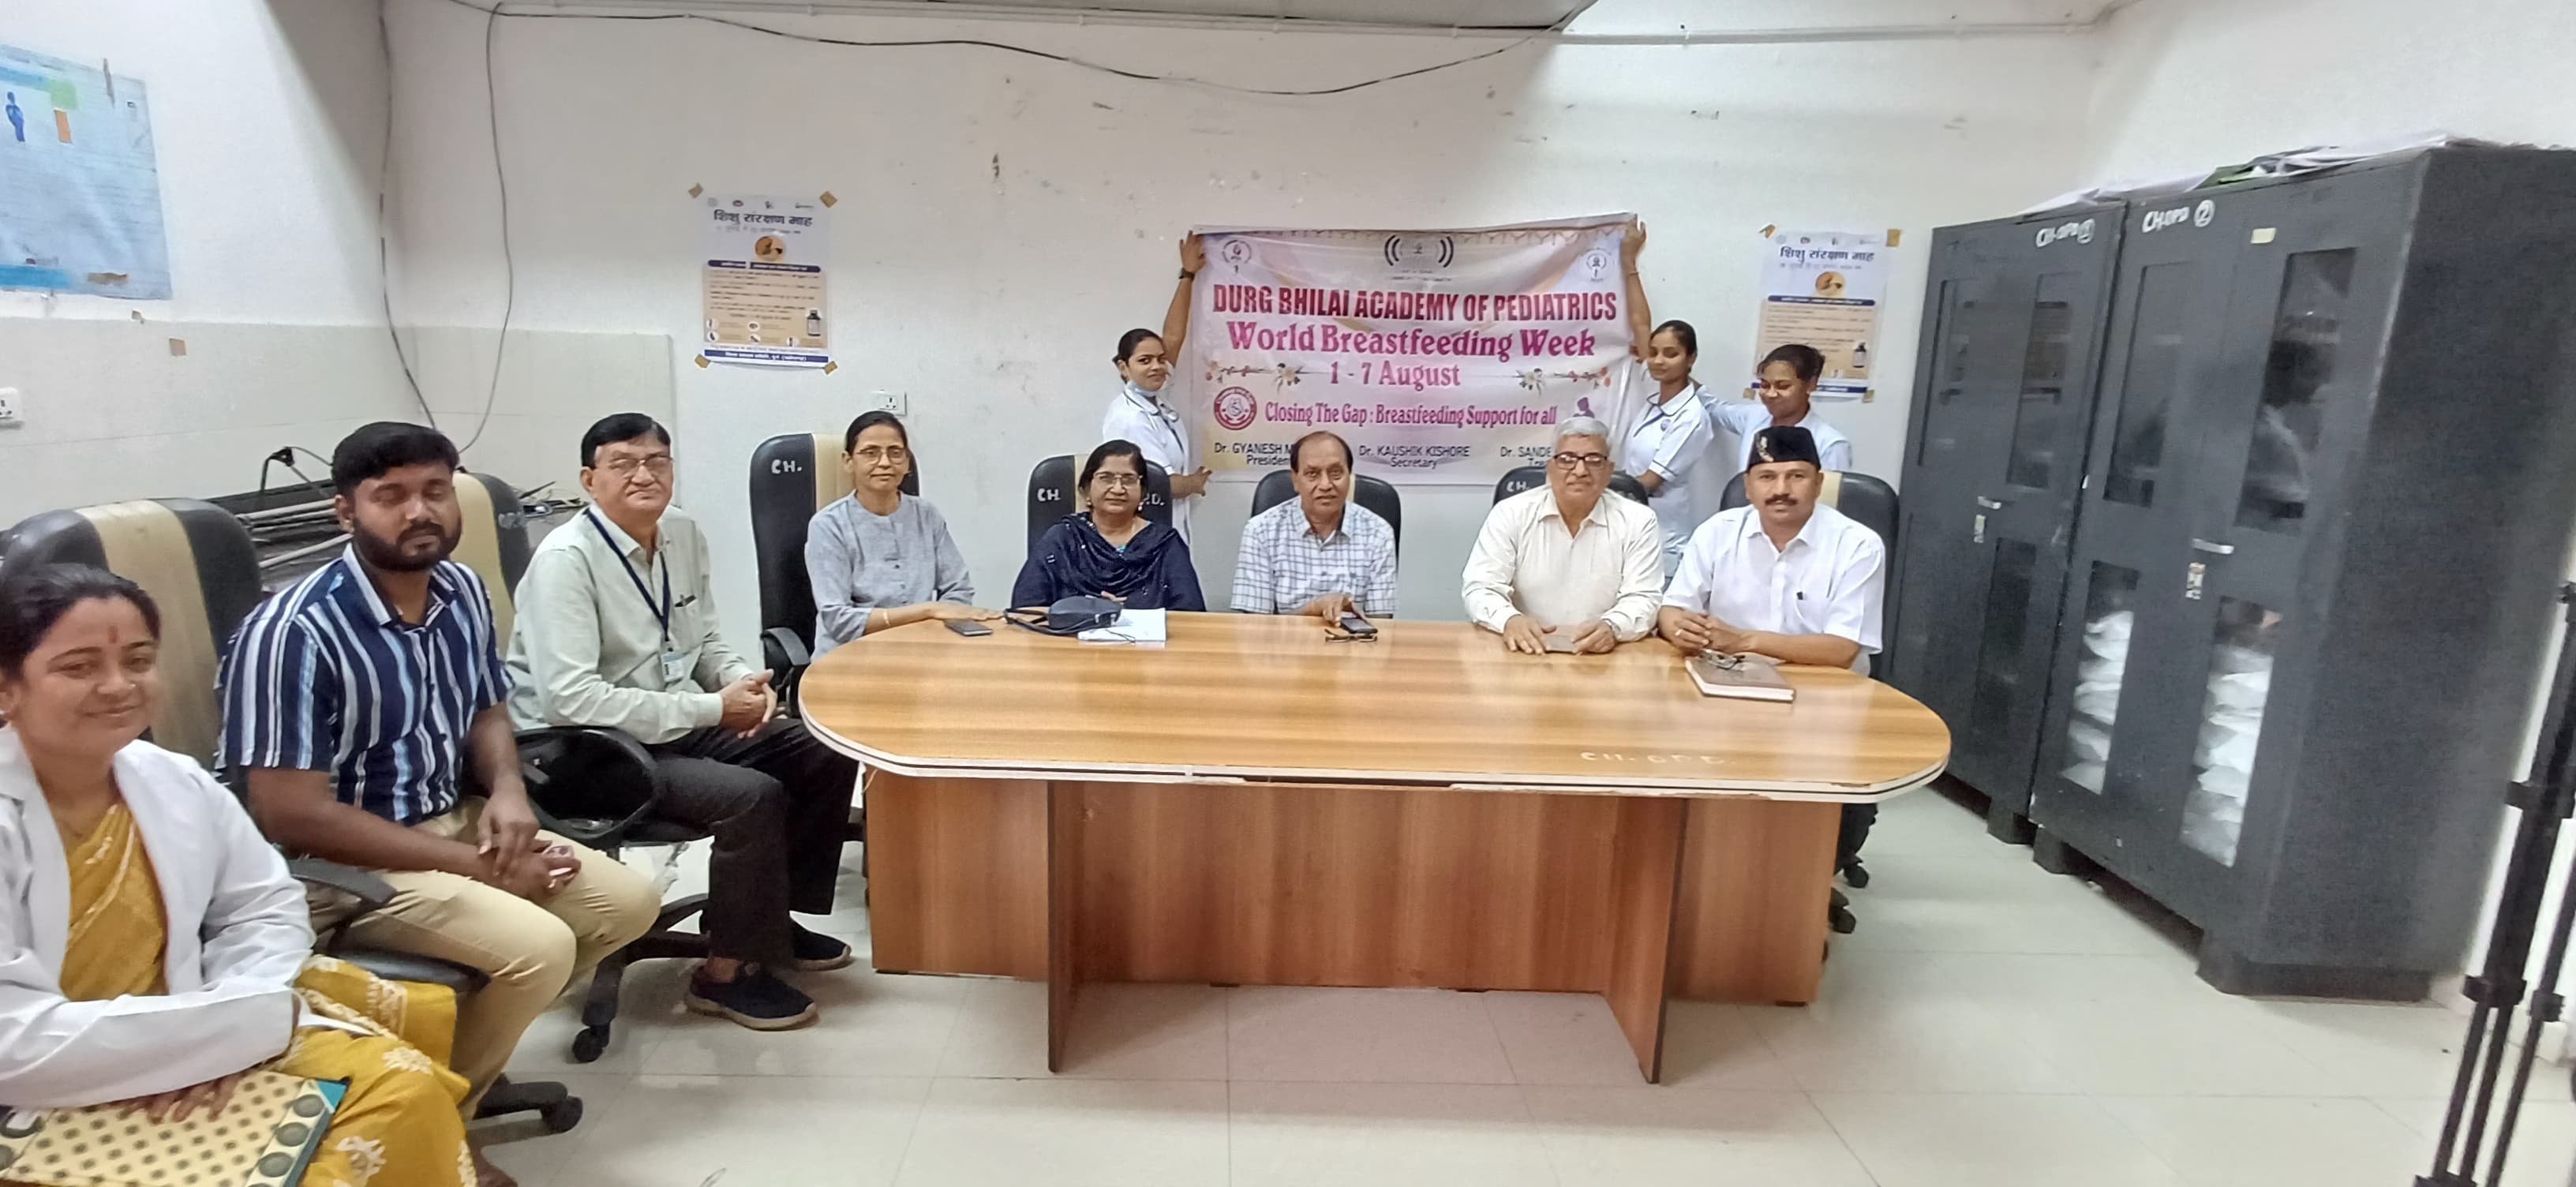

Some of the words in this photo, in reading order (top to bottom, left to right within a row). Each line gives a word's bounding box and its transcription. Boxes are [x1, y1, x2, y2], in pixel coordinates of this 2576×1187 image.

[1213, 284, 1272, 313] DURG
[1279, 287, 1350, 316] BHILAI
[1354, 290, 1458, 321] ACADEMY
[1463, 294, 1488, 321] OF
[1493, 292, 1616, 321] PEDIATRICS
[1226, 321, 1315, 350] World
[1320, 324, 1513, 362] Breastfeeding
[1520, 328, 1595, 356] Week
[1331, 361, 1339, 384] 1
[1361, 362, 1372, 384] 7
[1379, 360, 1461, 391] August
[1265, 402, 1313, 426] Closing
[1316, 403, 1339, 422] The
[1342, 403, 1367, 427] Gap
[1376, 404, 1465, 428] Breastfeeding
[1466, 405, 1518, 428] Support
[1520, 406, 1540, 425] for
[1541, 406, 1558, 425] all
[1215, 443, 1230, 453] Dr.
[1232, 443, 1282, 454] GYANESH
[1359, 445, 1374, 456] Dr.
[1377, 445, 1423, 456] KAUSHIK
[1426, 446, 1471, 456] KISHORE
[1500, 446, 1515, 457] Dr.
[1518, 447, 1552, 457] SANDE
[772, 459, 802, 474] CH.
[1247, 455, 1291, 465] Presiden
[1391, 457, 1437, 470] Secretary
